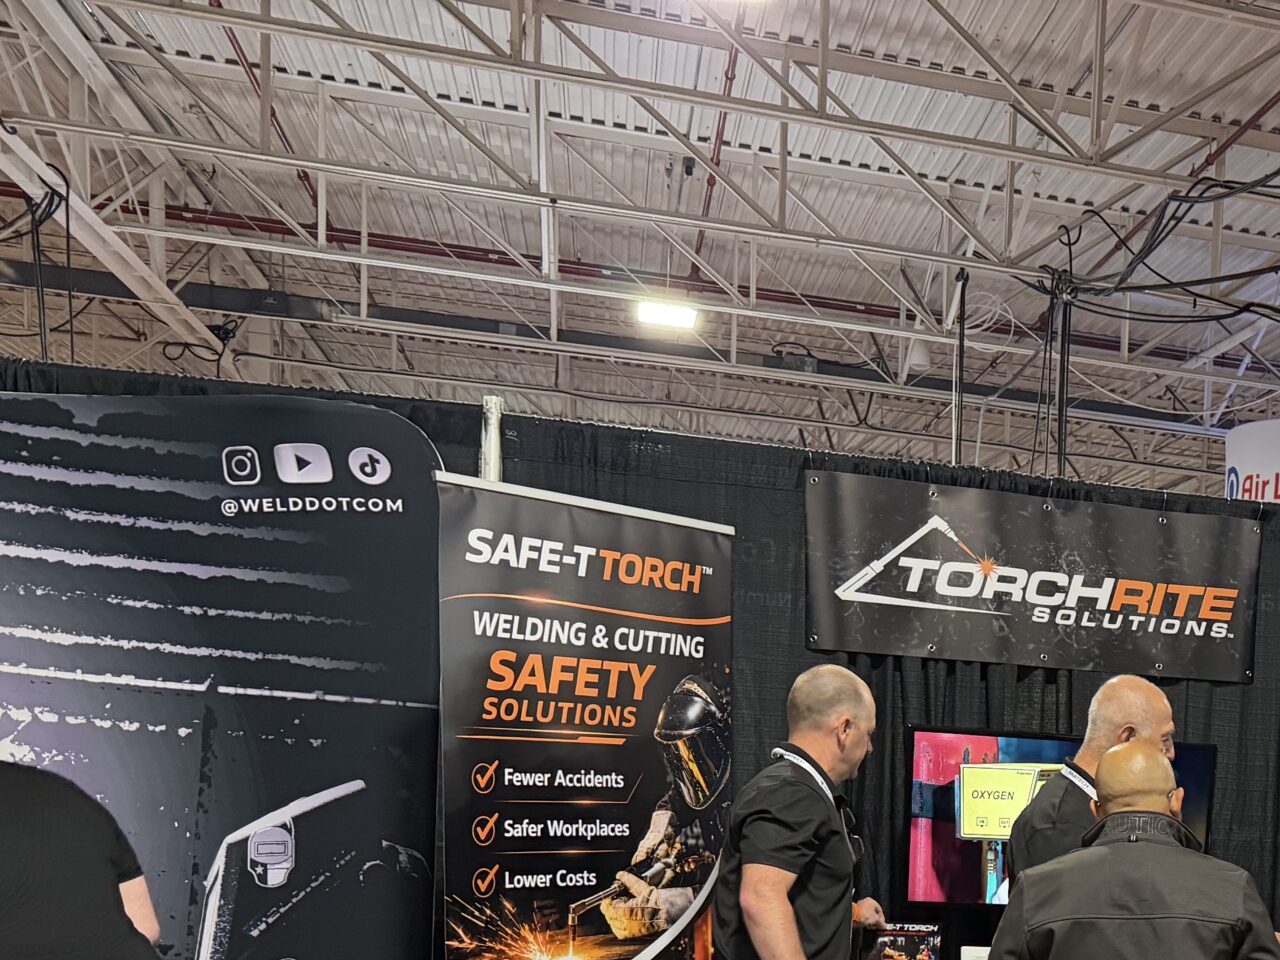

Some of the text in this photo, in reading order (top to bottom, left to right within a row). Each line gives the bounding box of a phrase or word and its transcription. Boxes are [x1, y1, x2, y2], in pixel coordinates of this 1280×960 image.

[1242, 473, 1270, 500] Air
[221, 497, 403, 516] @WELDDOTCOM
[465, 528, 596, 577] SAFE-T
[899, 557, 1238, 621] TORCHRITE
[473, 611, 705, 658] WELDING & CUTTING
[486, 650, 656, 700] SAFETY
[482, 697, 637, 728] SOLUTIONS
[504, 768, 624, 788] Fewer Accidents
[971, 789, 1015, 800] OXYGEN
[504, 819, 630, 840] Safer Workplaces
[505, 870, 597, 888] Lower Costs
[904, 924, 938, 932] TORCH
